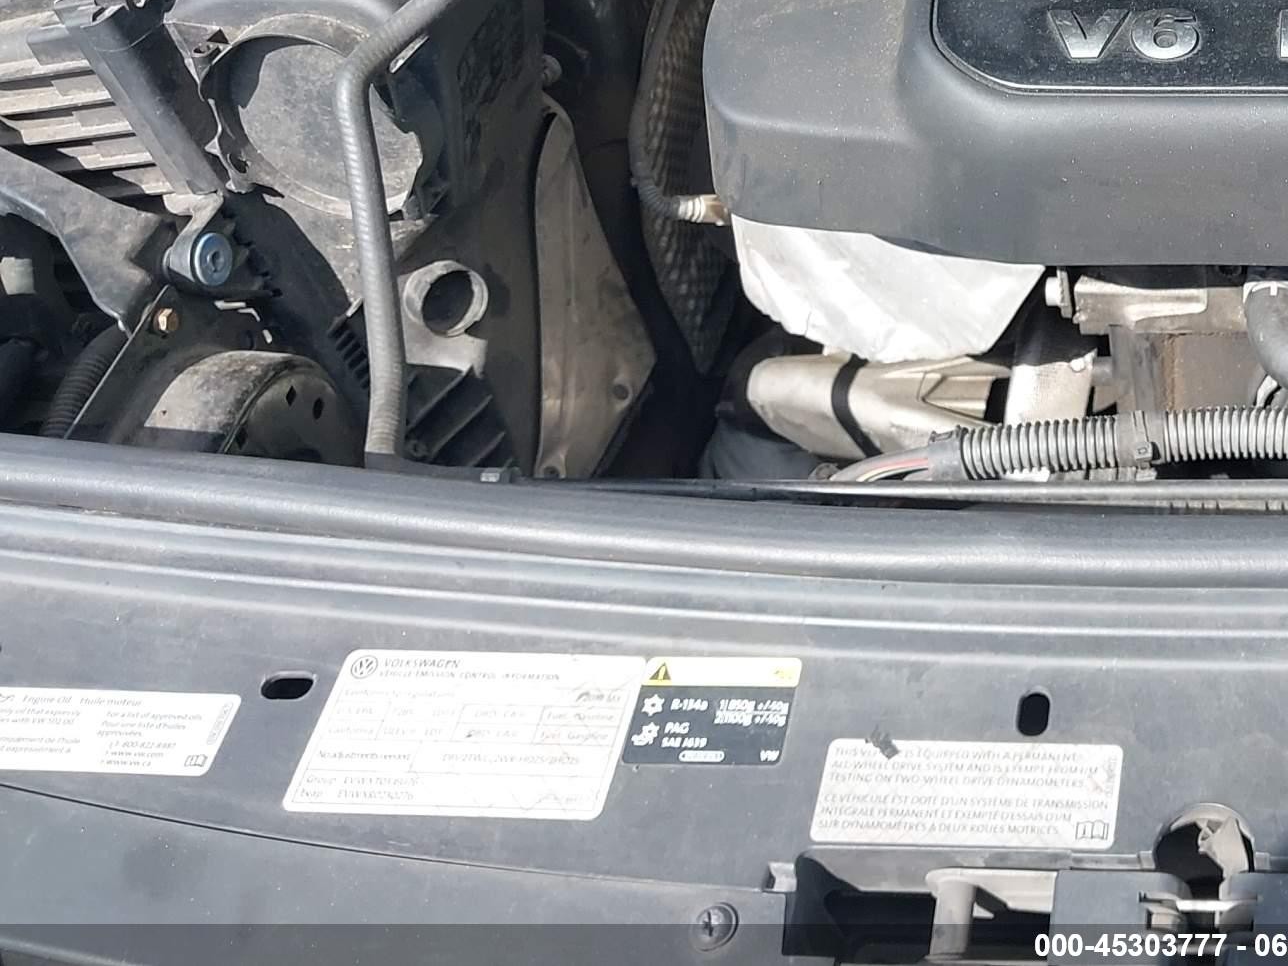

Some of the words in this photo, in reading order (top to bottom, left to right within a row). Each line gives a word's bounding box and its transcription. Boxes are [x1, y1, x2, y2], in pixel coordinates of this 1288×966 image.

[1047, 8, 1201, 62] V6
[384, 658, 460, 669] VOLKSWAGEN
[80, 697, 105, 706] Huile
[664, 722, 690, 734] PAG
[835, 748, 858, 756] THIS
[973, 750, 1000, 759] WITH
[892, 762, 921, 770] DRIVE
[926, 763, 964, 771] SYSTEM
[967, 764, 991, 772] AND
[830, 772, 872, 783] TESTING
[875, 773, 892, 782] ON
[963, 776, 993, 786] DRIVE
[997, 776, 1084, 787] DYNAMOMETERS
[824, 794, 836, 802] CE
[891, 794, 908, 804] EST
[1016, 798, 1029, 808] DE
[1033, 799, 1108, 810] TRANSMISSION
[878, 809, 938, 818] PERMANENT
[818, 820, 840, 828] SUR
[939, 822, 967, 832] DEUX
[970, 824, 1004, 835] ROUES
[1008, 825, 1058, 835] MOTRICES
